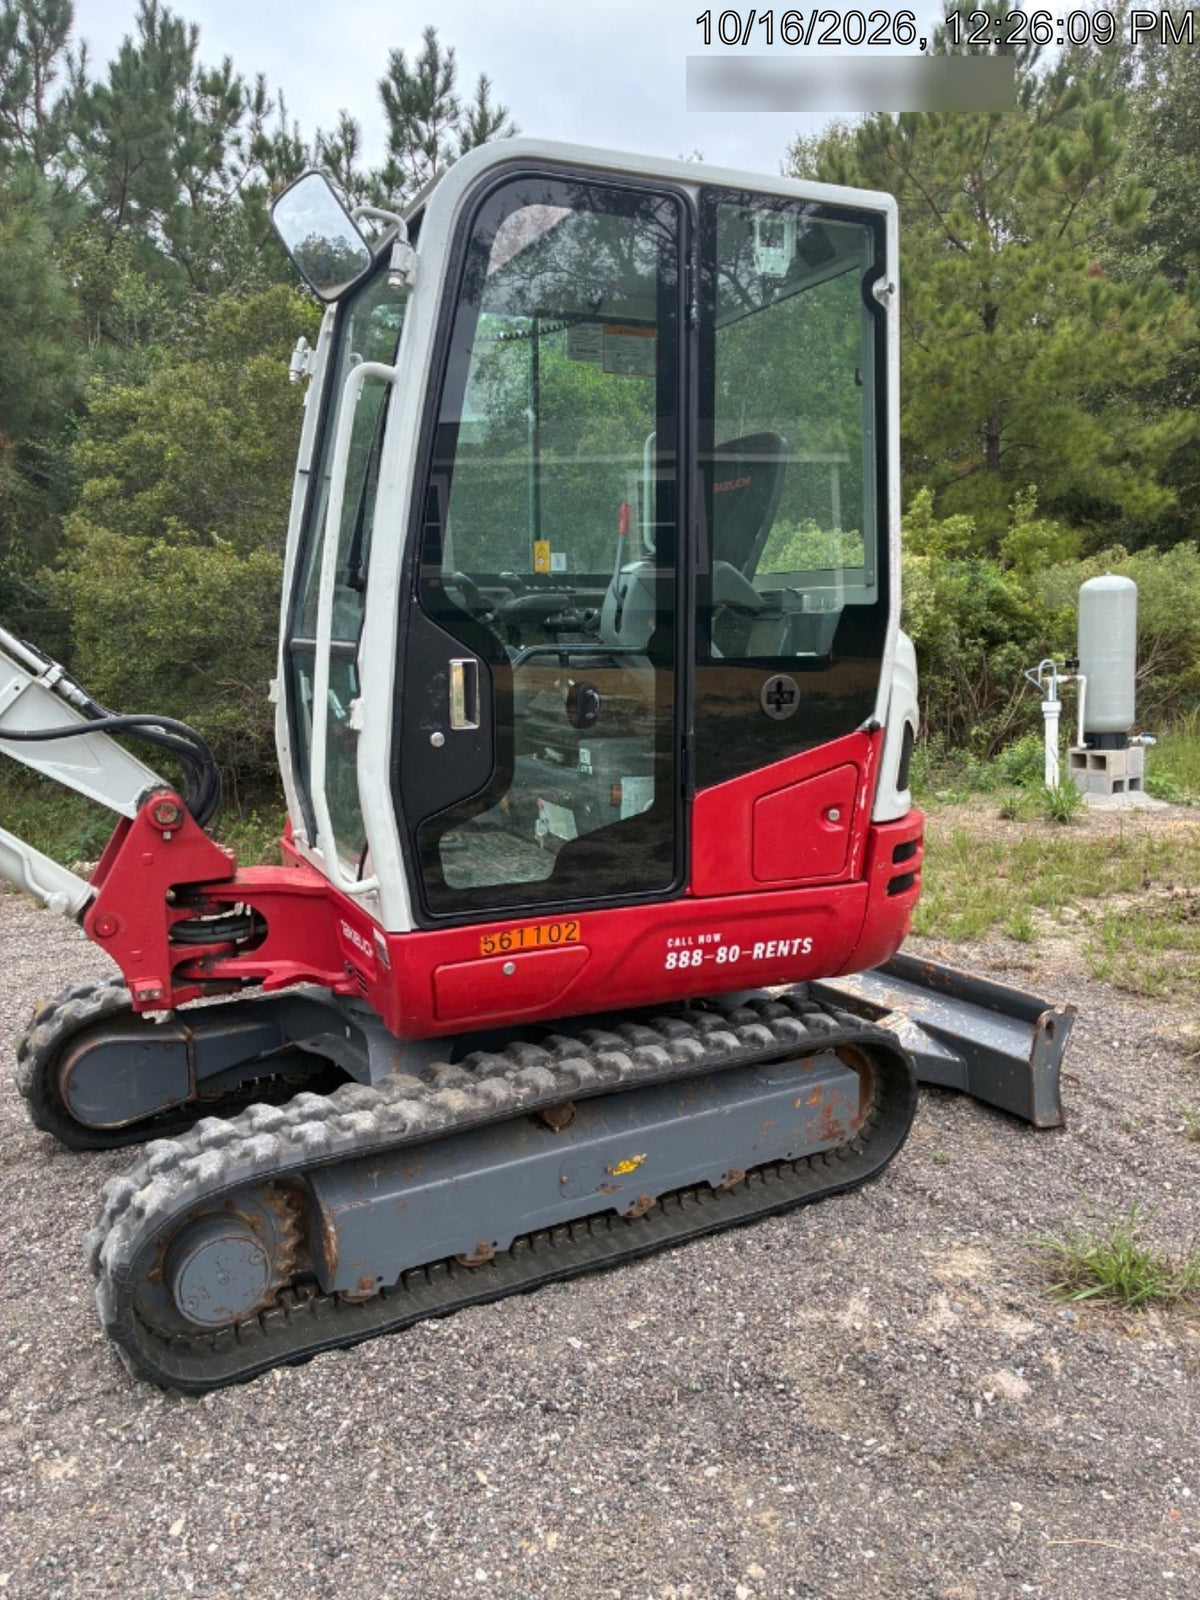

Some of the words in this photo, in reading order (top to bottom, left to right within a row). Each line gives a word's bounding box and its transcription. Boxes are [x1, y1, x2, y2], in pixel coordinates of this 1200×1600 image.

[483, 921, 577, 954] 561102
[665, 937, 813, 970] 888-80-RENTS
[667, 937, 693, 948] CALL
[698, 933, 722, 944] NOW
